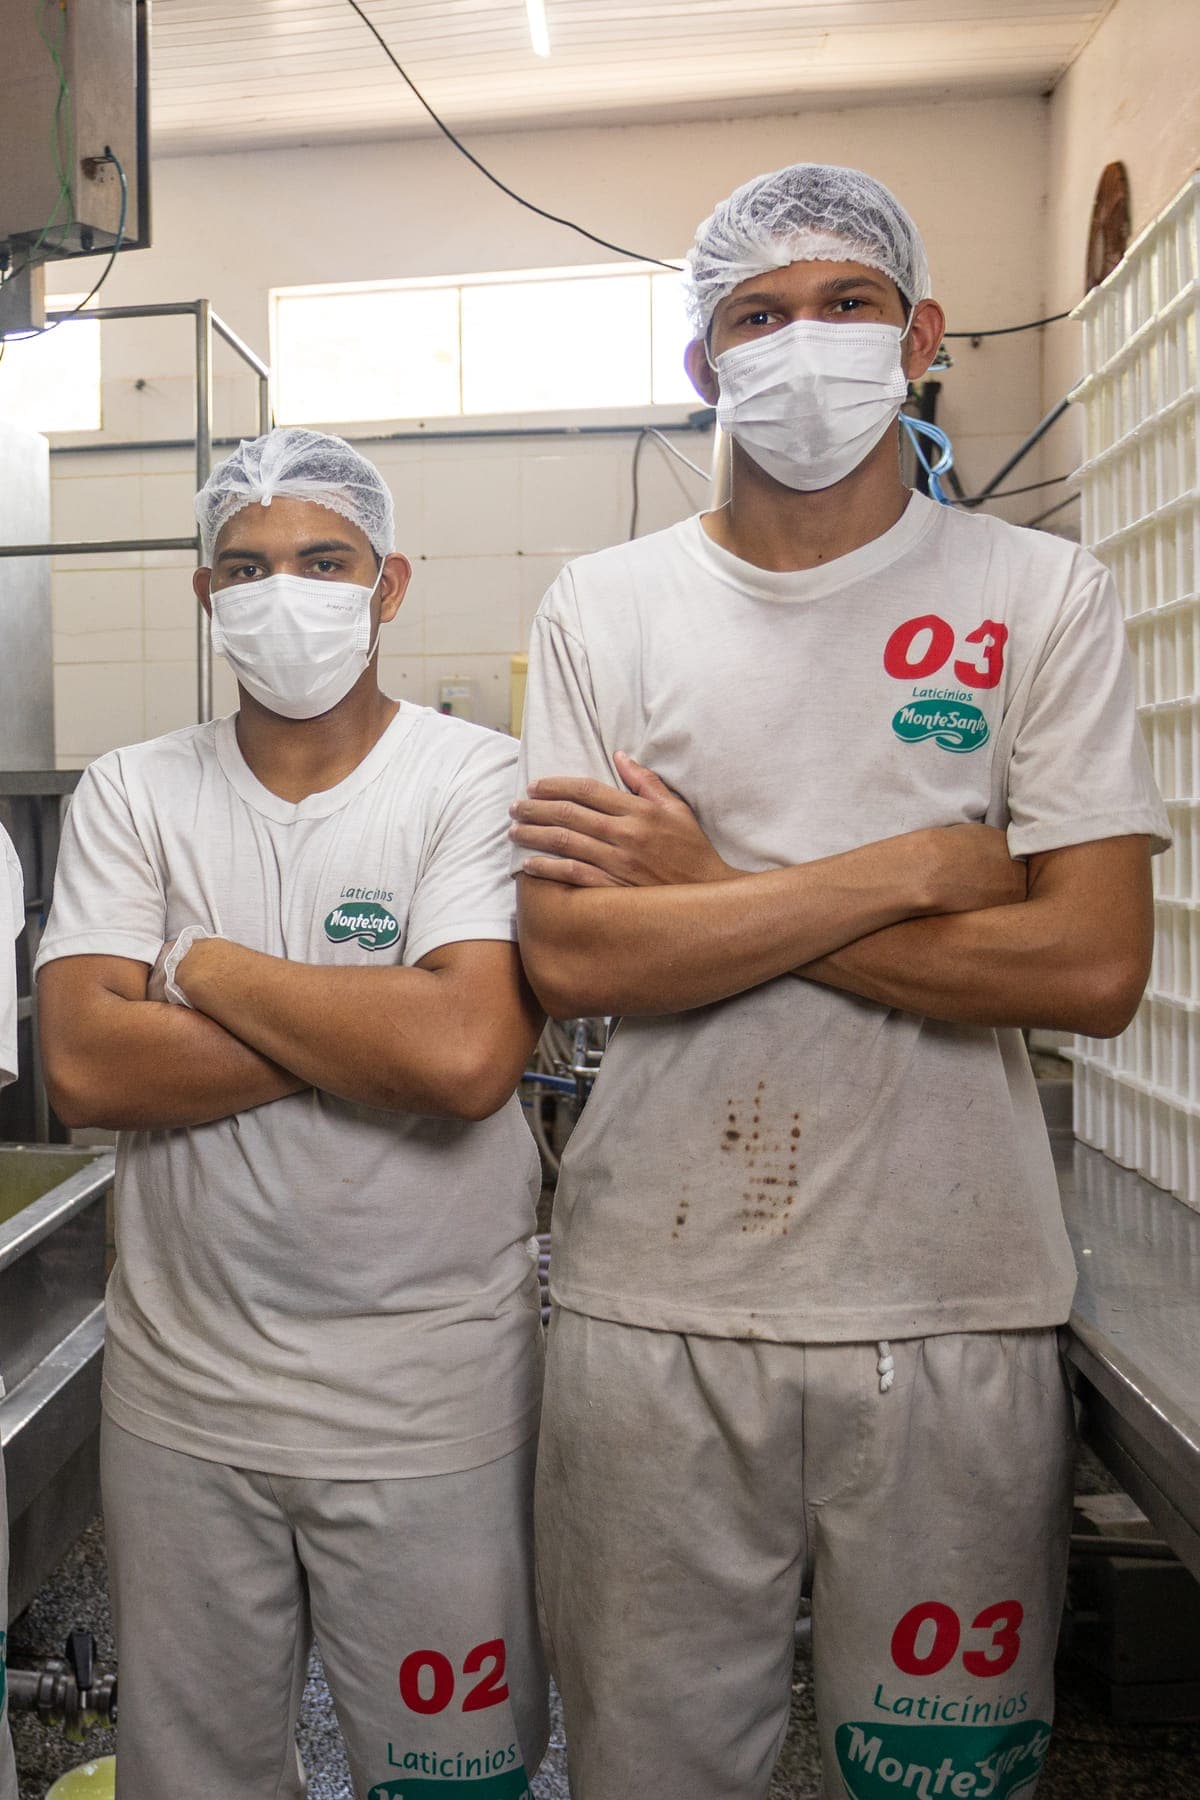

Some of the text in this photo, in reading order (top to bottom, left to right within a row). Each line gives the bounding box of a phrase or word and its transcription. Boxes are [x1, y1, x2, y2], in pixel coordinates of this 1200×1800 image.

[883, 614, 1009, 690] 03
[912, 687, 974, 702] Laticínios
[899, 707, 986, 733] MonteSanto
[890, 1599, 1025, 1678] 03
[399, 1637, 510, 1715] 02
[873, 1683, 1029, 1723] Laticínios
[387, 1742, 516, 1777] Laticínios
